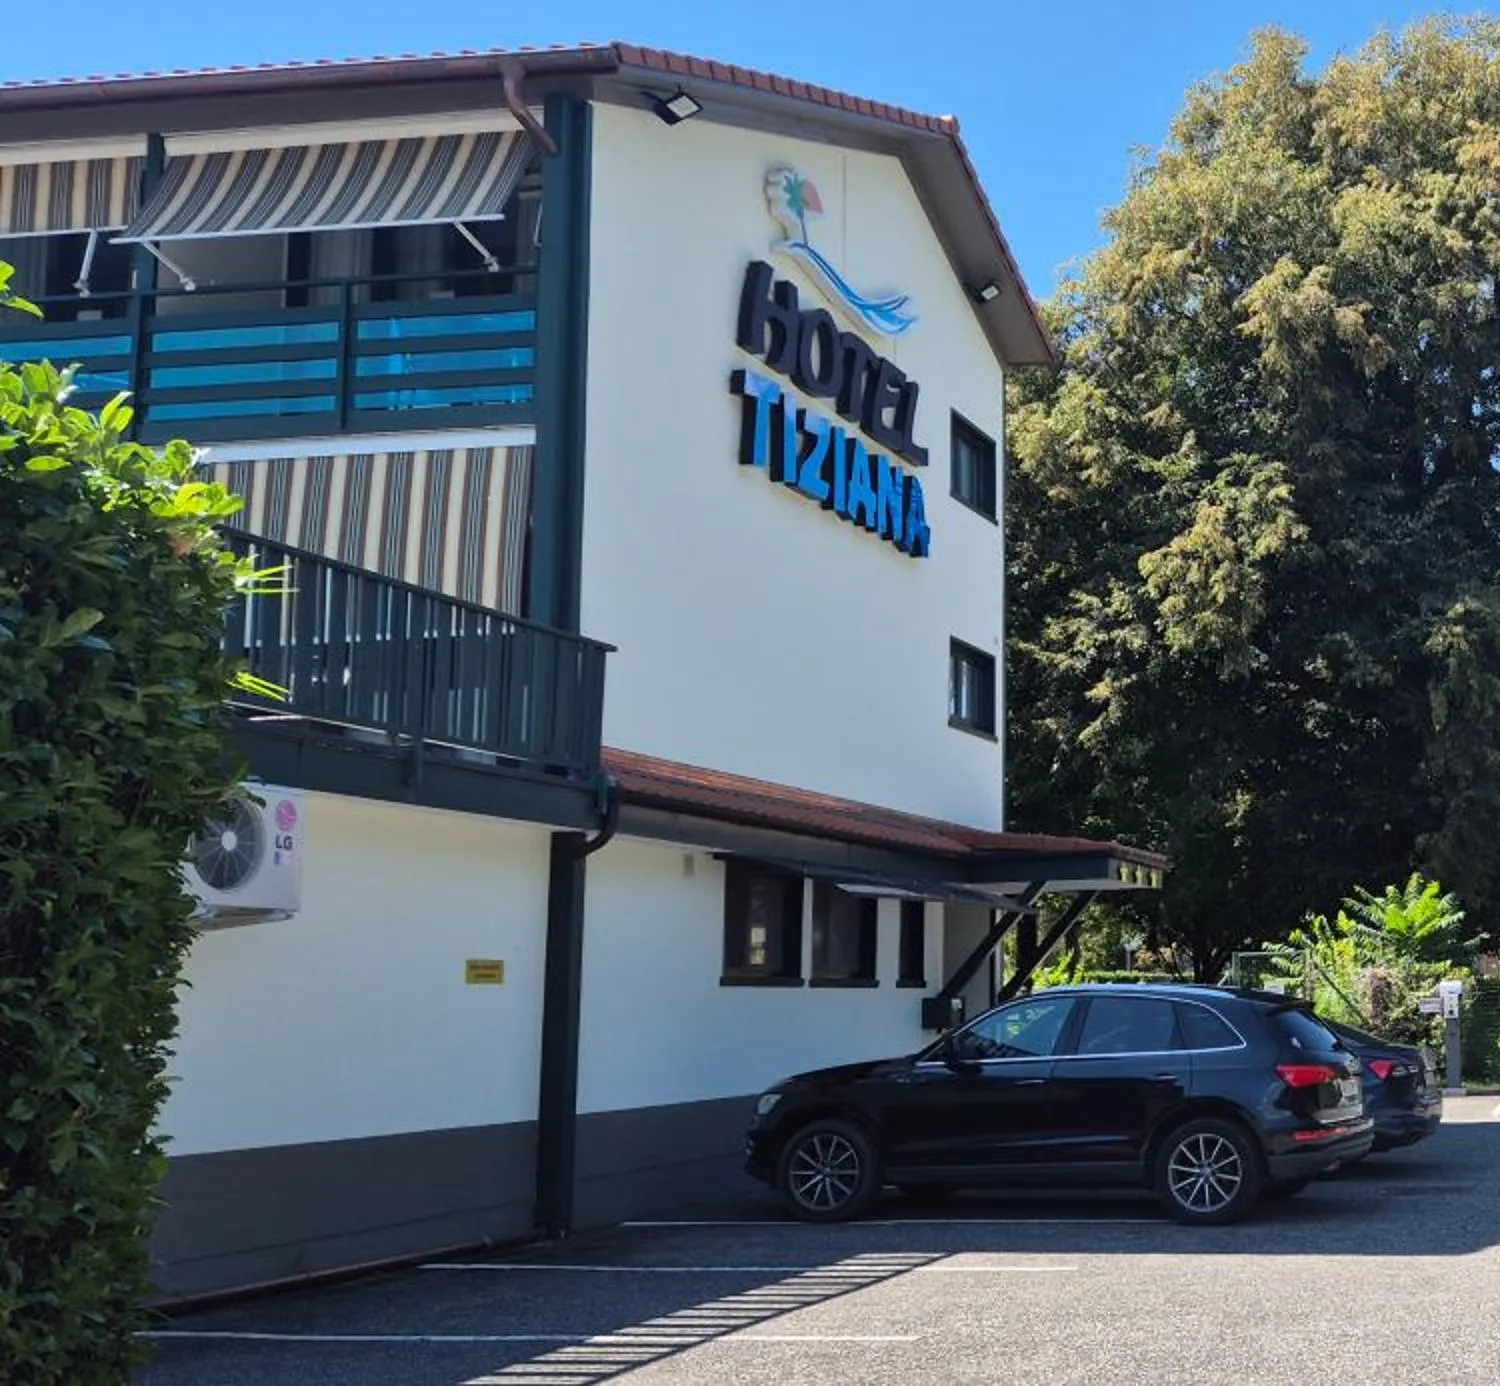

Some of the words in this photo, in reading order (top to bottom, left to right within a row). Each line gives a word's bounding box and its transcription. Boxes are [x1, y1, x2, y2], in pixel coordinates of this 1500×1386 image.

[736, 260, 929, 466] HOTEL
[730, 369, 931, 557] TIZIANA
[275, 835, 292, 851] LG
